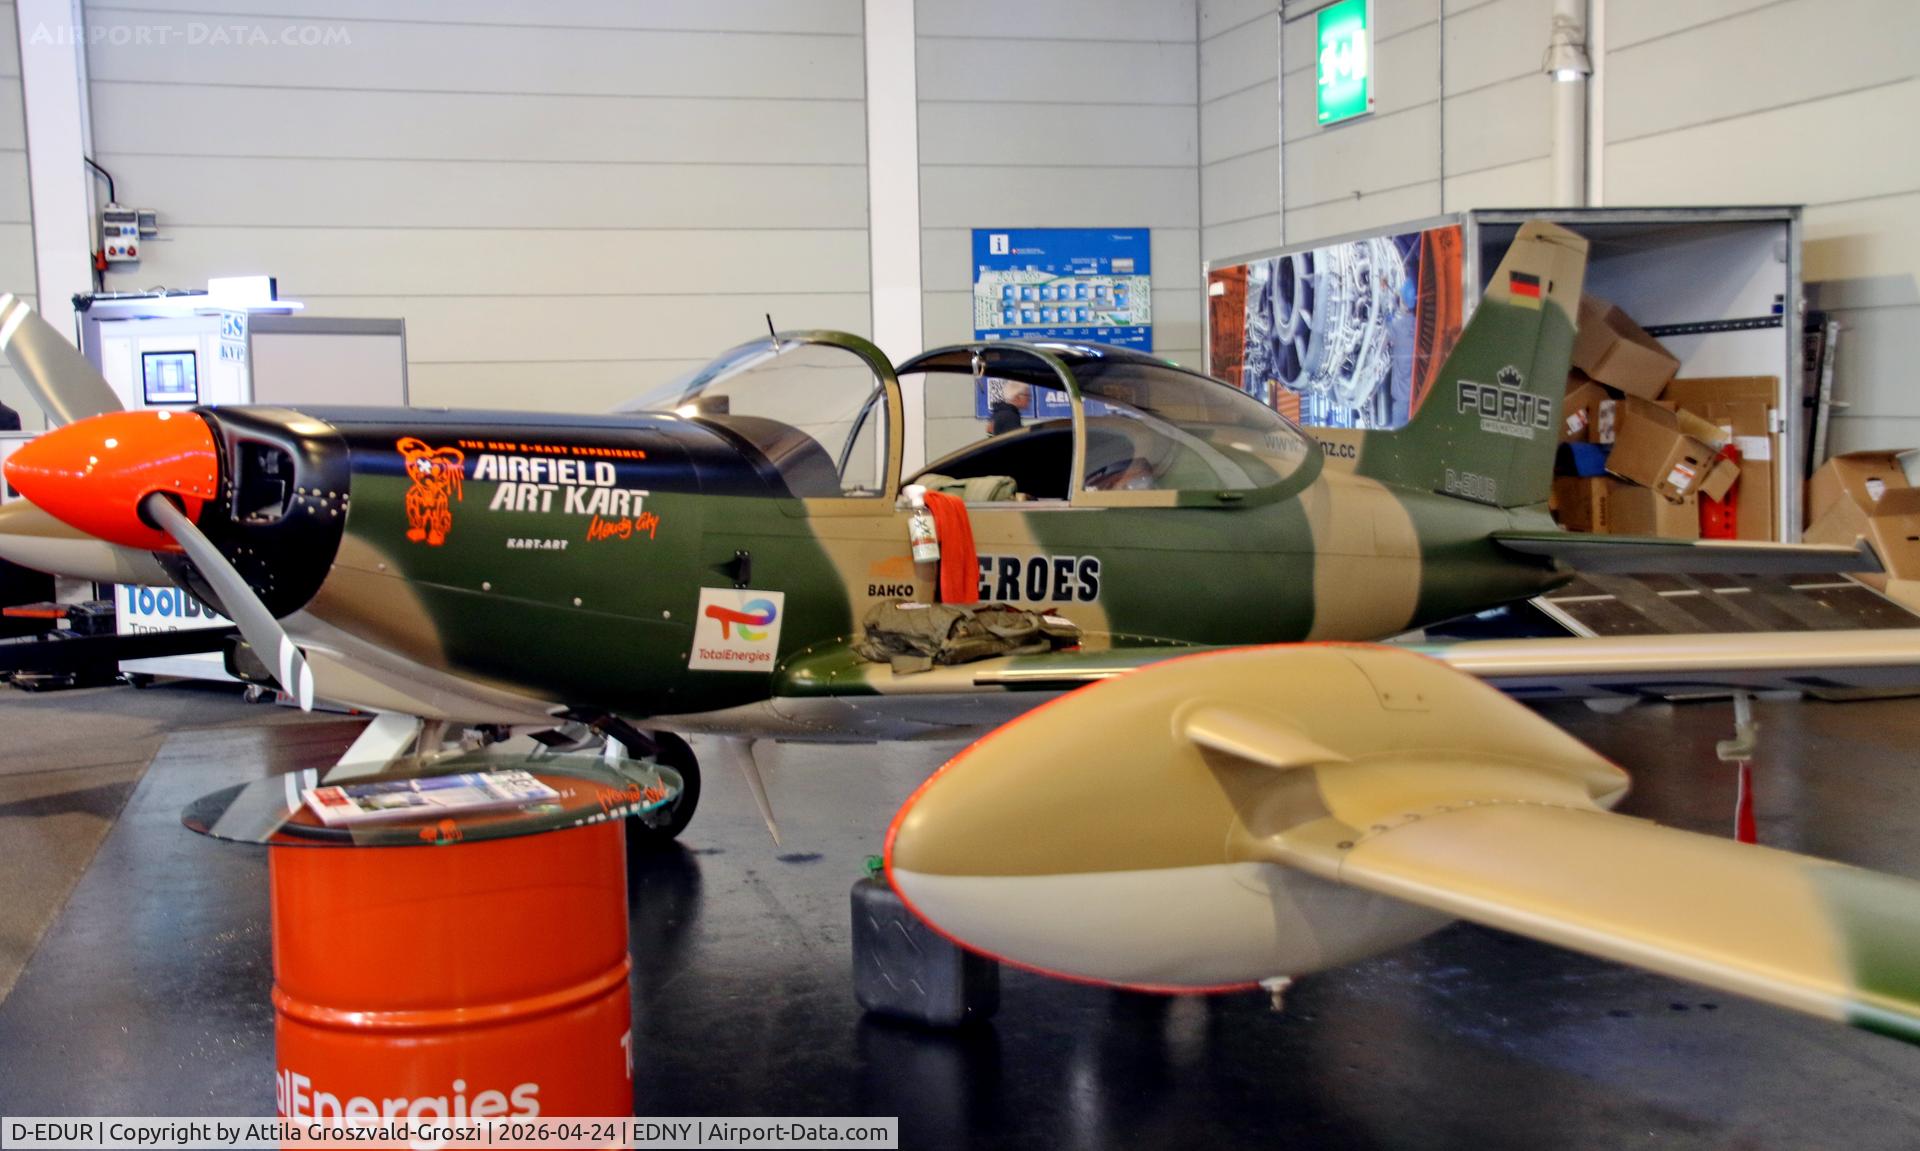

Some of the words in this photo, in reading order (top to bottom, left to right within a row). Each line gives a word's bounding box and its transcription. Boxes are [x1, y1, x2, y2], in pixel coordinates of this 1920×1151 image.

[1457, 380, 1551, 430] FORTIS
[458, 439, 485, 449] THE
[488, 441, 517, 451] NEW
[520, 443, 568, 455] E-KART
[572, 446, 647, 459] EXPERIENCE
[473, 454, 617, 487] AIRFIELD
[489, 482, 559, 513] ART
[564, 486, 650, 517] KART
[506, 538, 568, 550] KART.ART
[868, 584, 914, 597] BAHCO
[977, 554, 1101, 603] EROES
[700, 648, 771, 663] TotalEnergies
